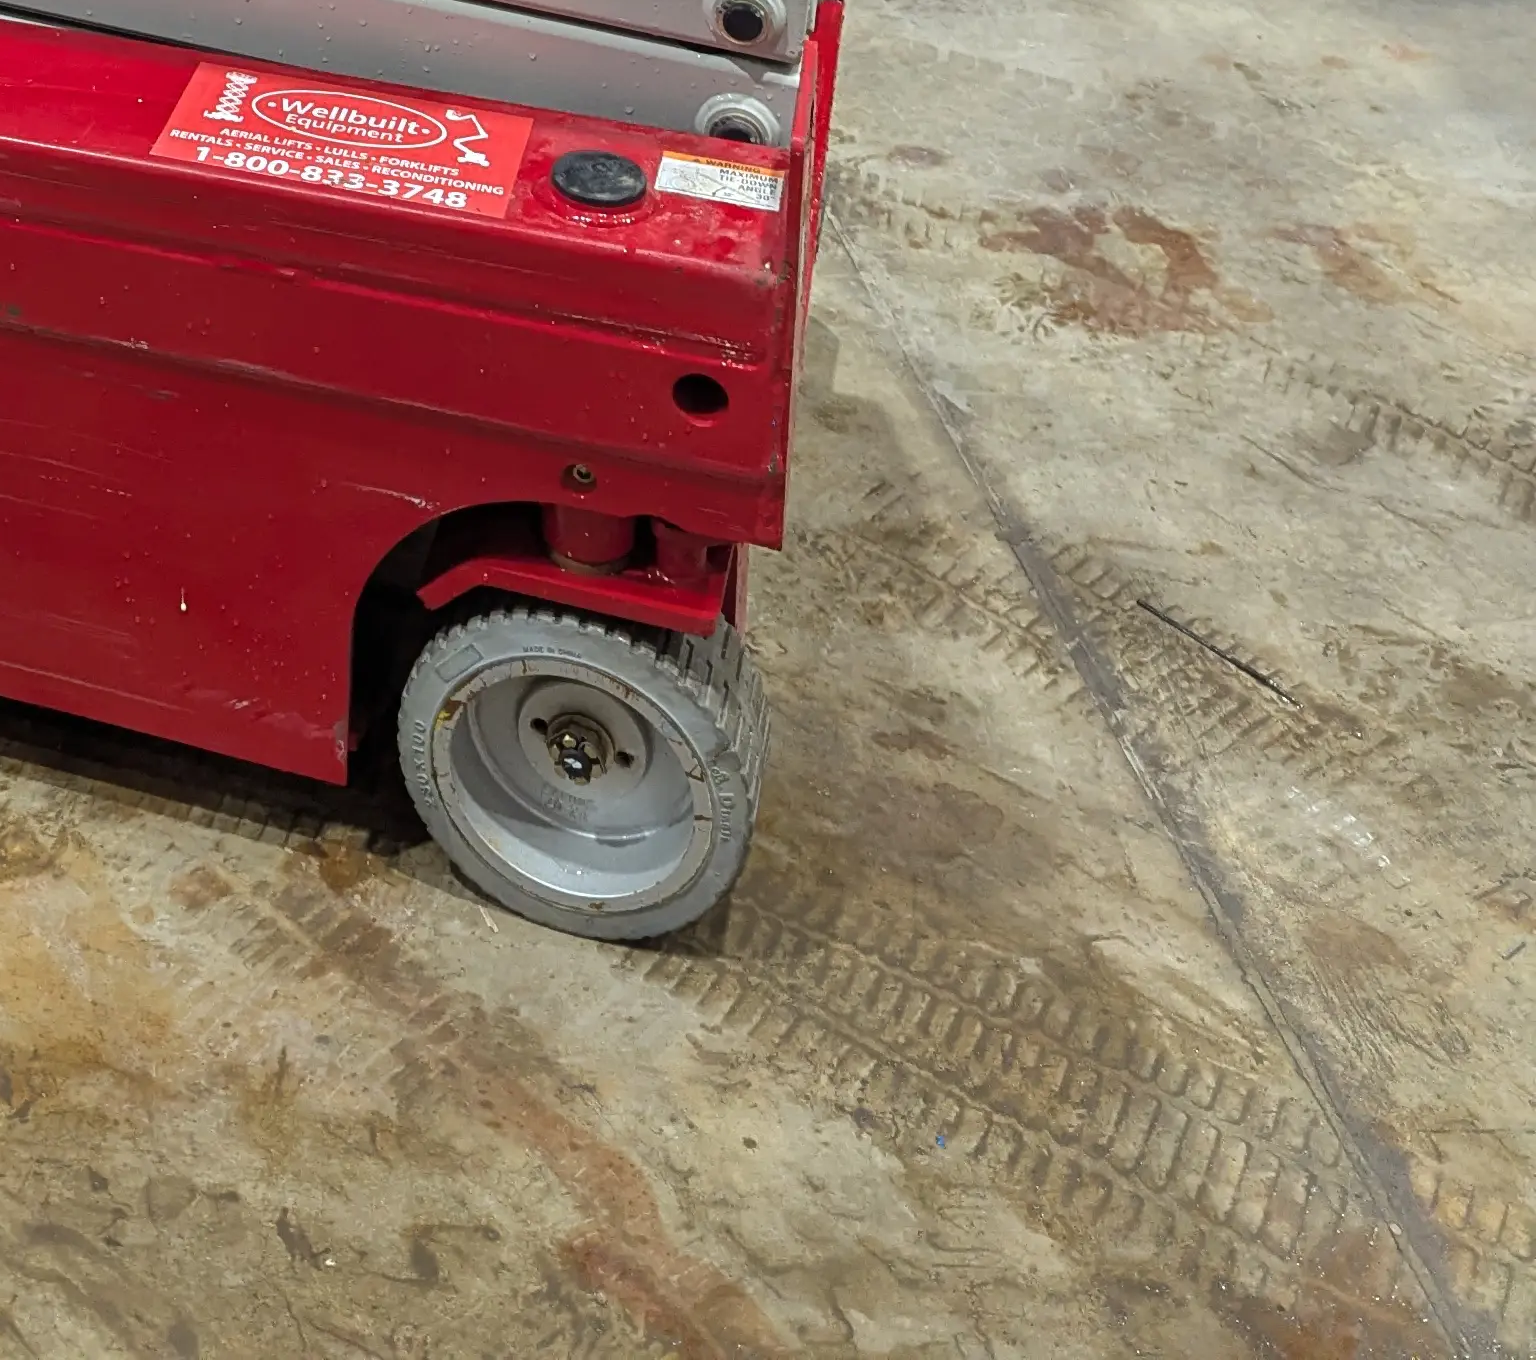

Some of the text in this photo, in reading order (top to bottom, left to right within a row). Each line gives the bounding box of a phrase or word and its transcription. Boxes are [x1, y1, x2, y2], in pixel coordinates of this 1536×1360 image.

[282, 97, 421, 136] Wellbuilt
[285, 113, 405, 144] Equipment
[169, 129, 505, 196] RENTALS SERVICE SALES RECONDITIONING
[219, 127, 461, 177] AERIAL LIFTS LULLS FORKLIFTS
[196, 145, 468, 209] 1-800-833-3748
[705, 159, 762, 175] WARNING
[719, 168, 780, 184] MAXIMUM
[719, 175, 778, 190] TIE-DOWN
[738, 184, 777, 196] ANGLE
[523, 645, 545, 654] MADE
